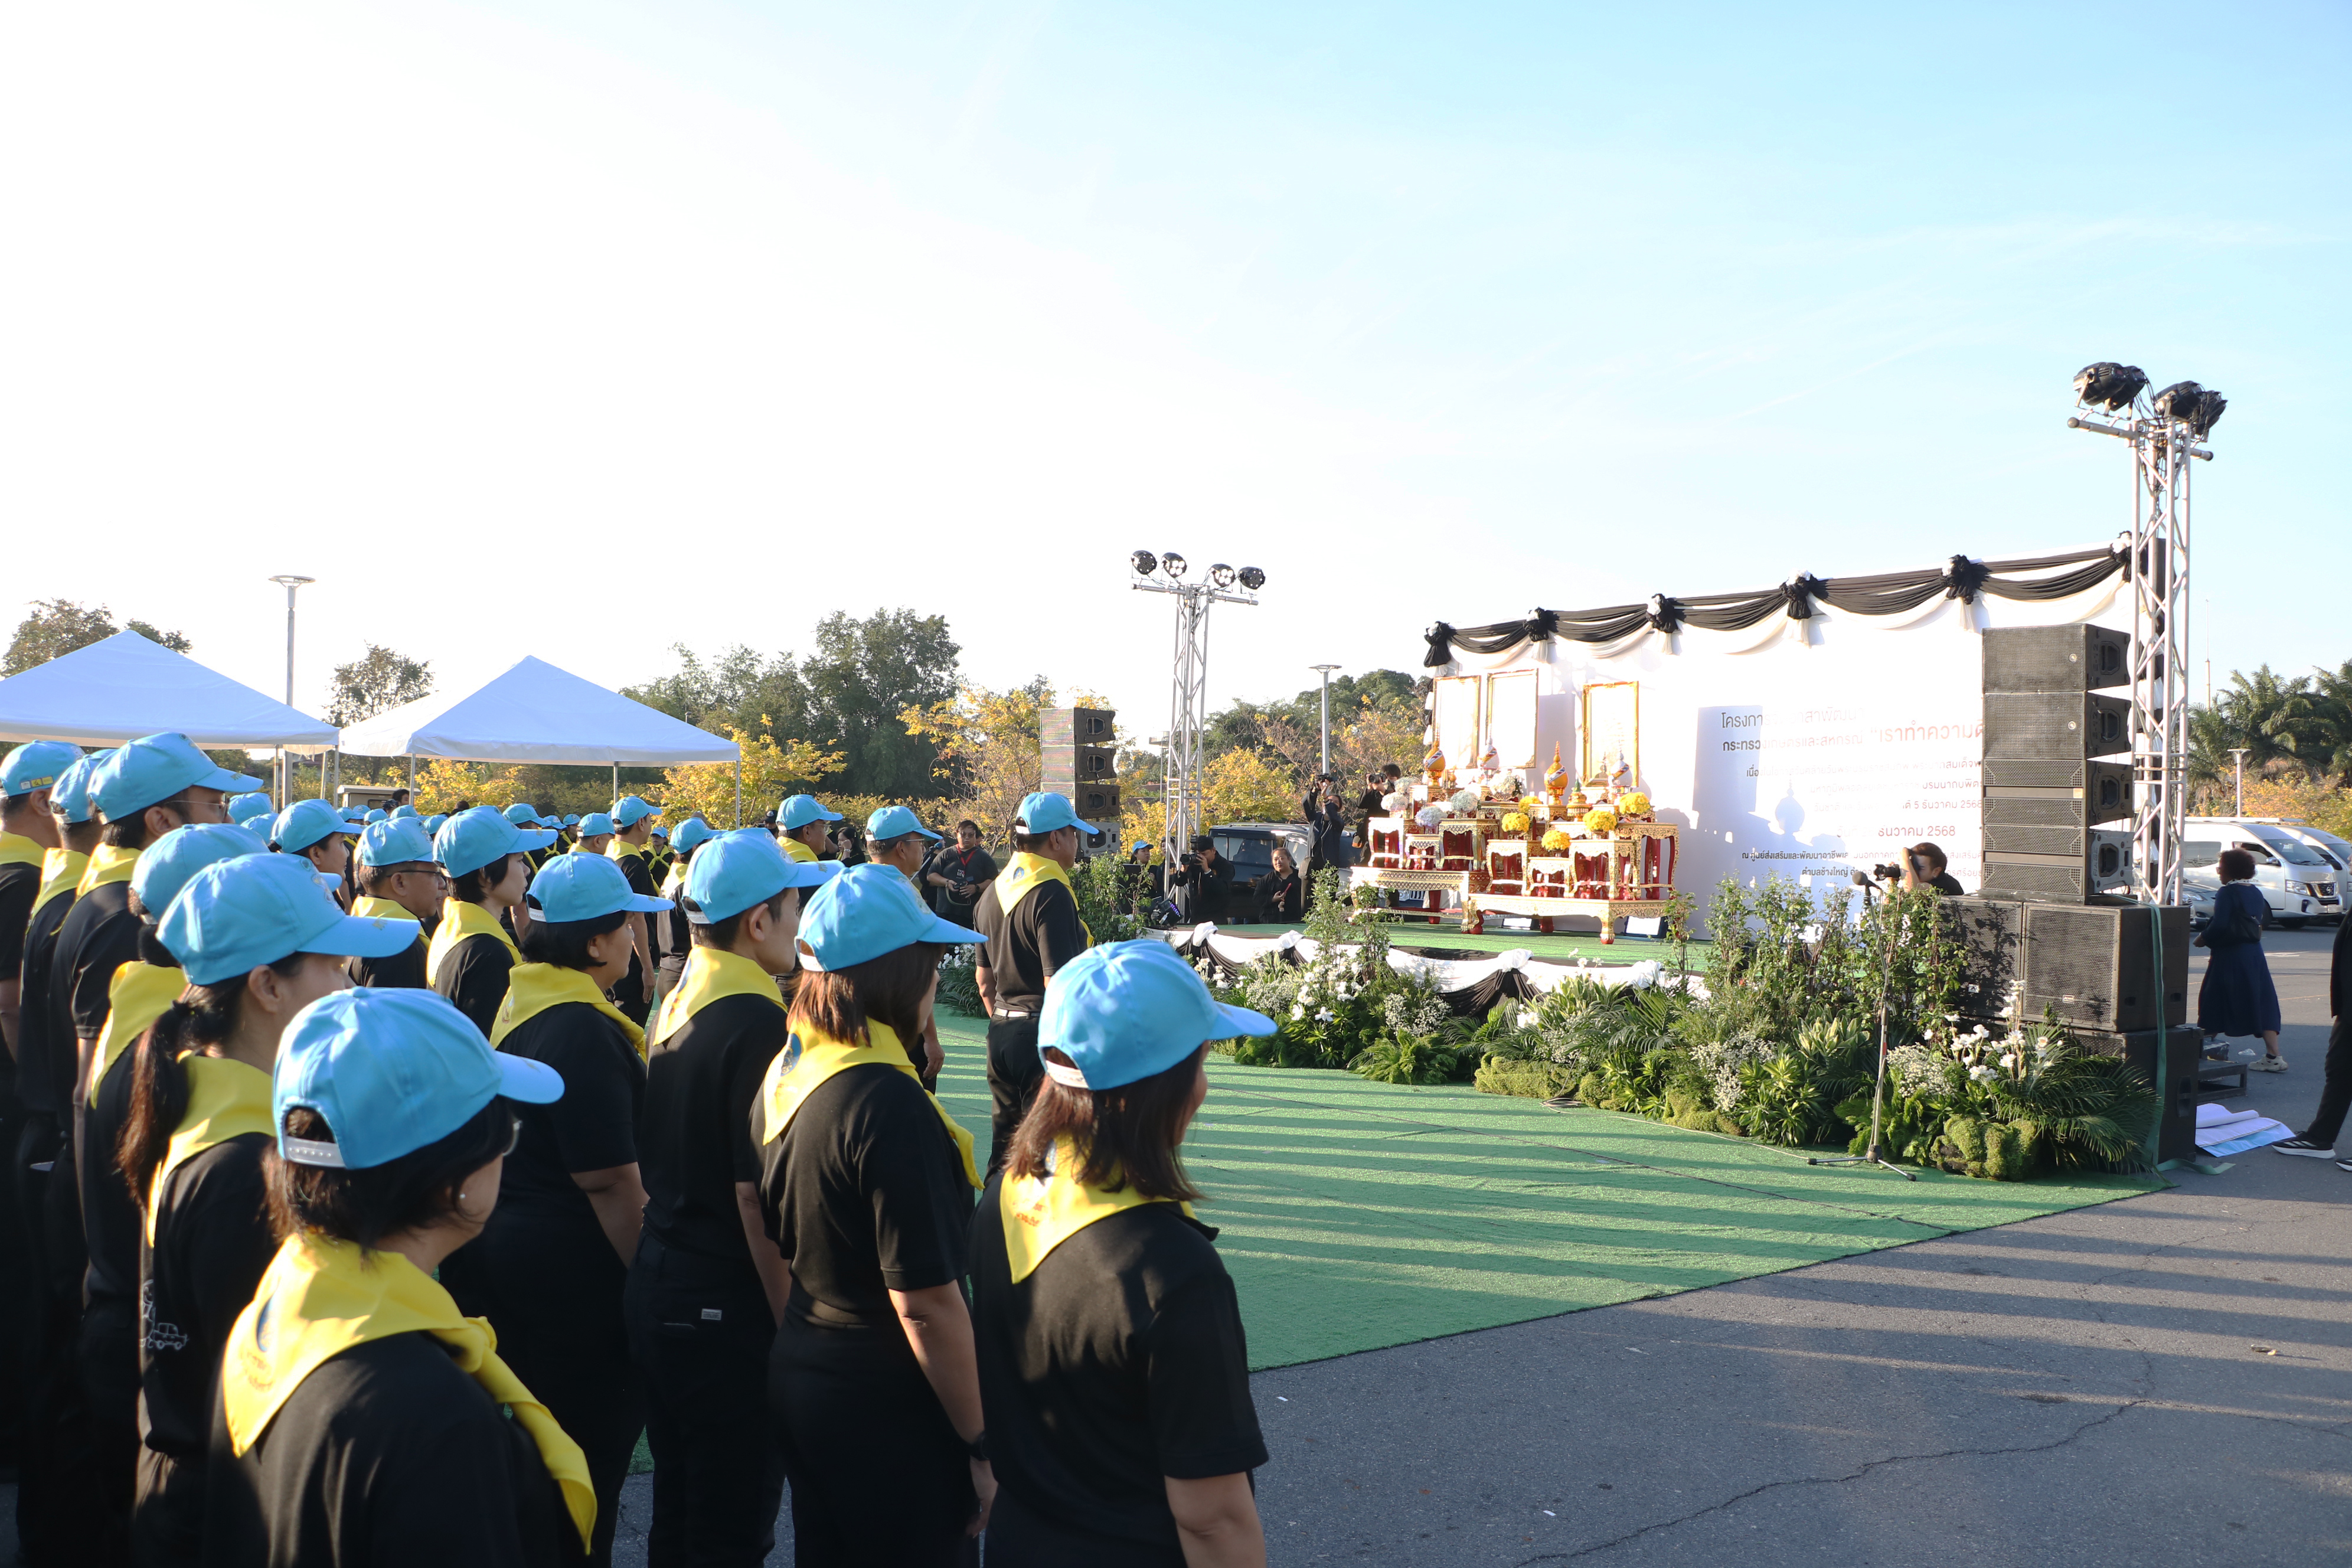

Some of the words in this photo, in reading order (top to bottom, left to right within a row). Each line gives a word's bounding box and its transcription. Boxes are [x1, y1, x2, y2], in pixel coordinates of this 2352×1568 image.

[1915, 801, 1919, 809] 5
[1922, 799, 1957, 809] ธันวาคม
[1961, 800, 1982, 808] 2568
[1927, 825, 1955, 837] 2568
[1802, 867, 1848, 877] ตำบลช้างใหญ่
